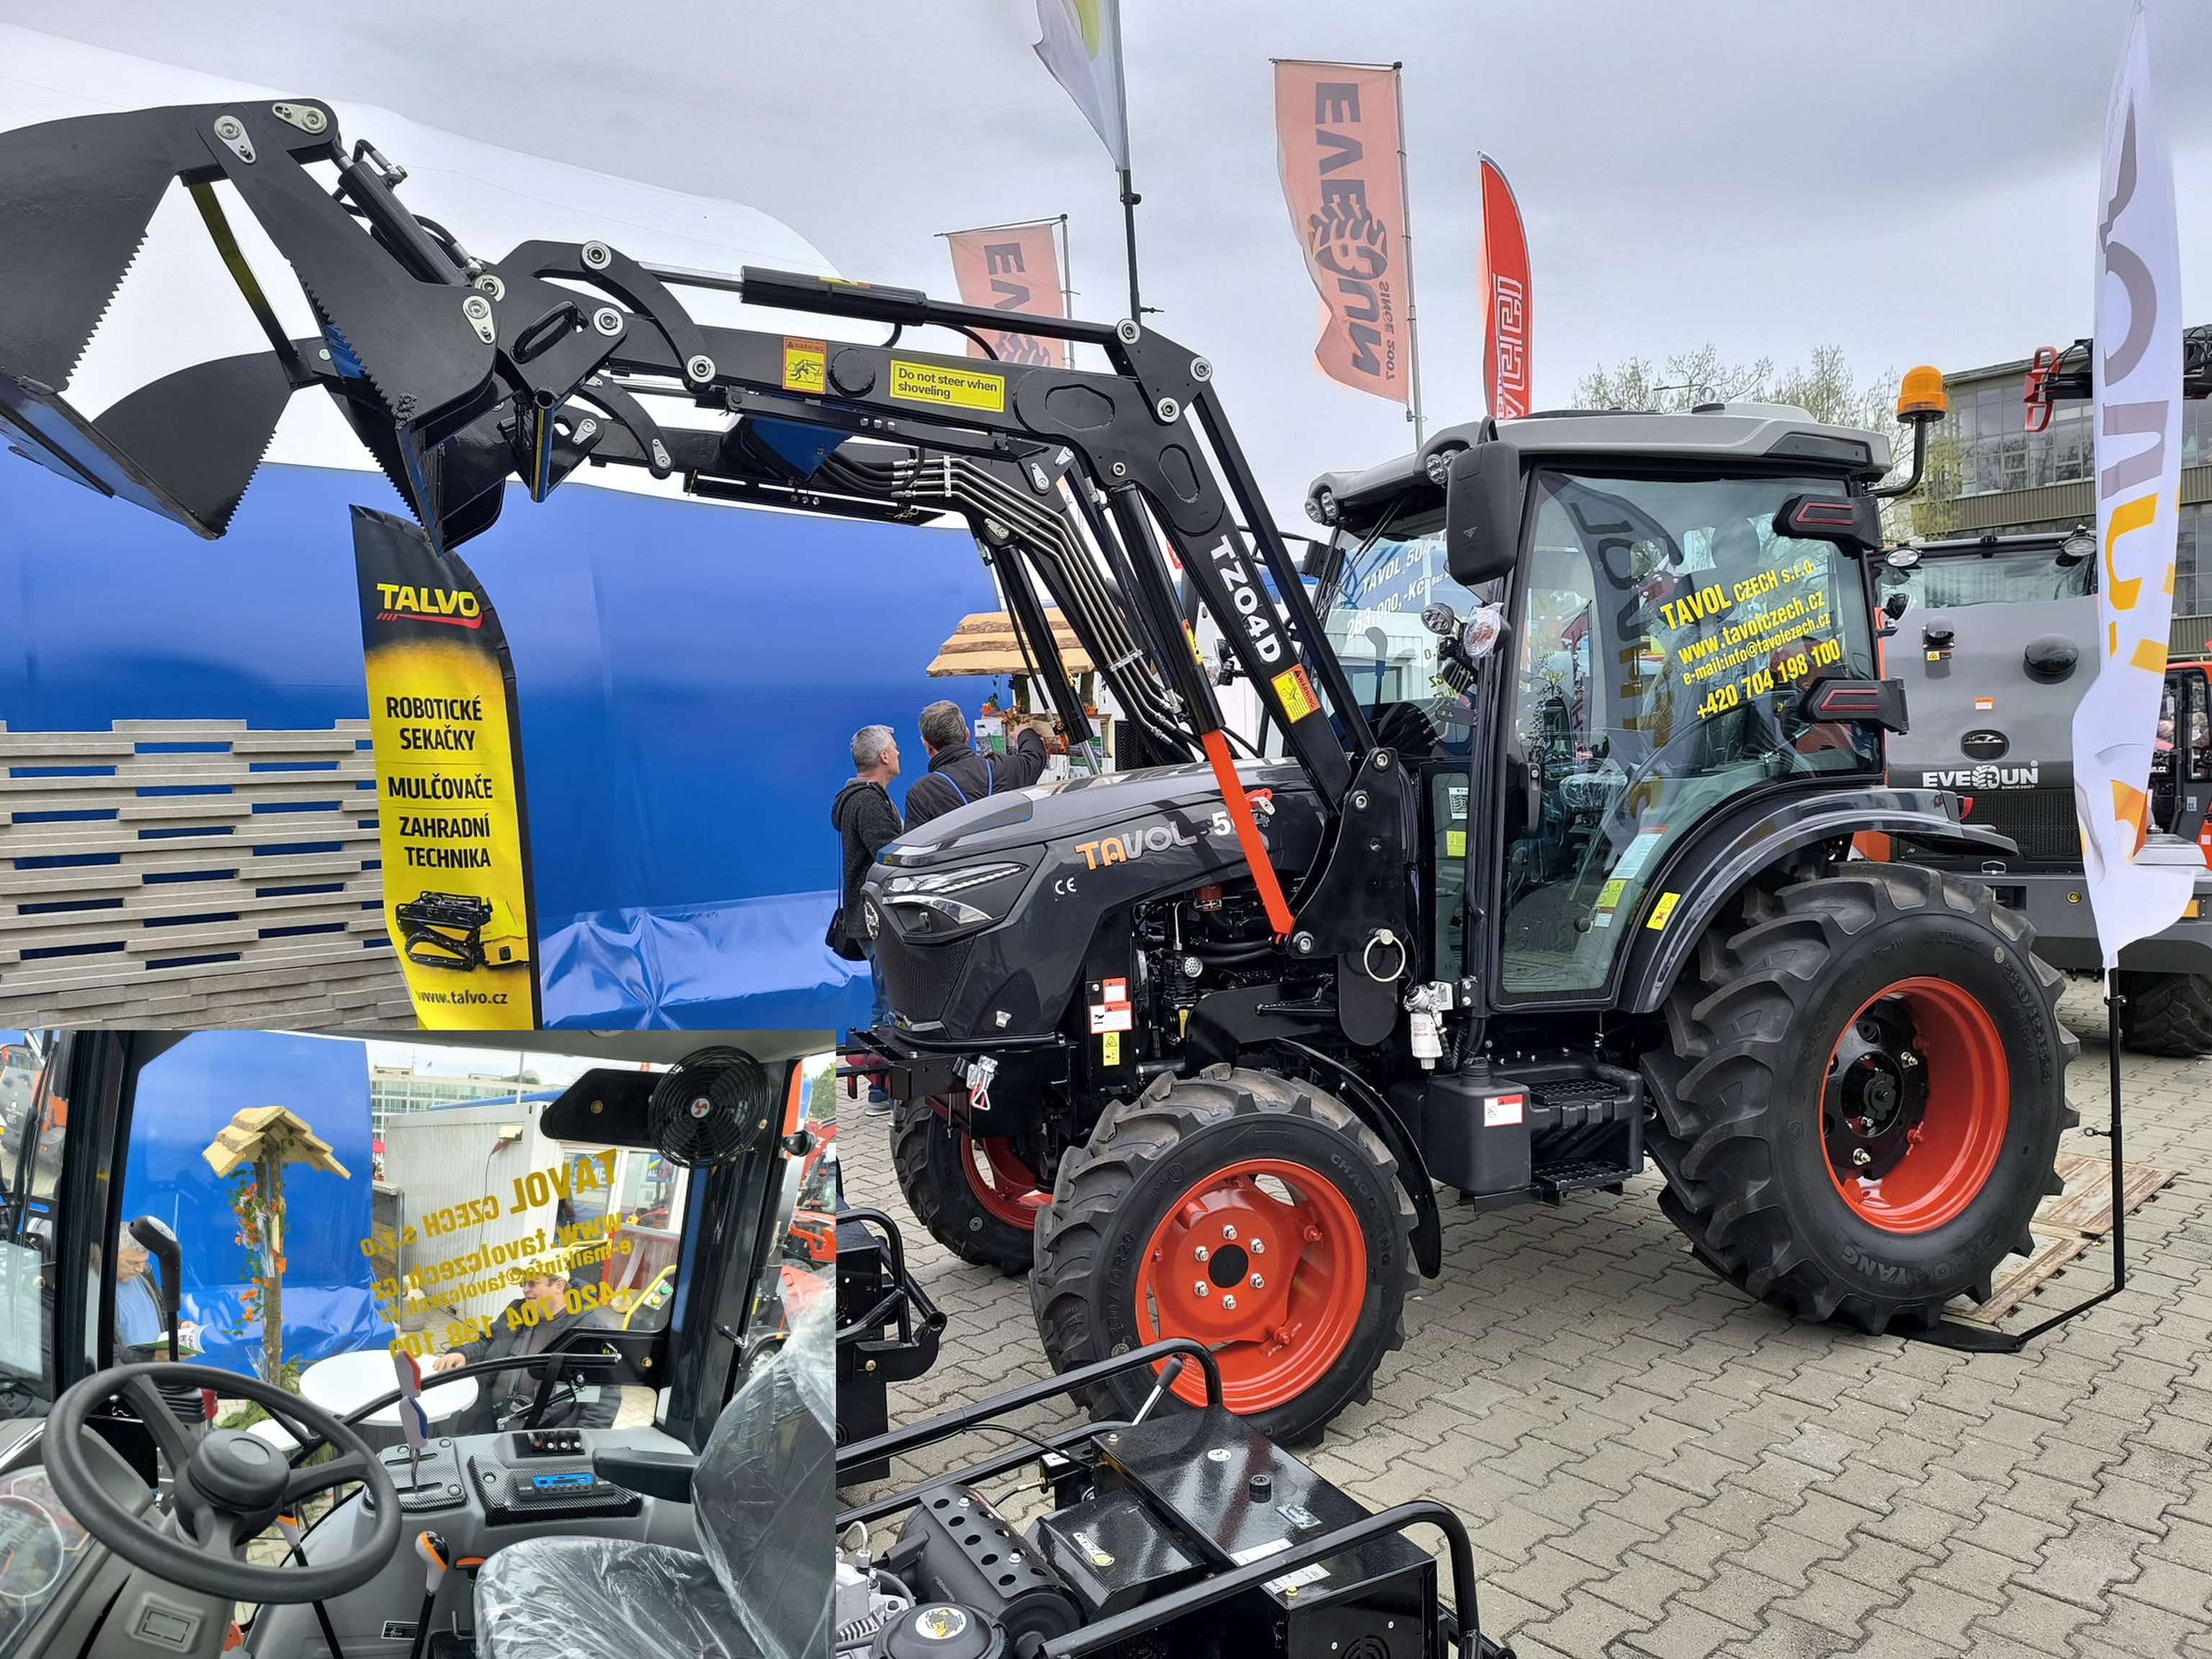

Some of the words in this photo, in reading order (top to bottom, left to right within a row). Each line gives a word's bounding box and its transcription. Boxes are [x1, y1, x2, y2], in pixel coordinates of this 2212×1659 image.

[898, 381, 951, 400] shoveling
[899, 367, 914, 379] Do
[917, 371, 936, 384] not
[938, 374, 965, 388] steer
[966, 379, 998, 392] when
[1362, 557, 1401, 595] TAVOL
[377, 583, 481, 617] TALVO
[1660, 583, 1732, 631] TAVOL
[1733, 570, 1779, 603] CZECH
[1677, 590, 1826, 666] www.tavolczech.cz
[1682, 611, 1831, 686] e-mail:info@tavolczech.cz
[1697, 684, 1739, 719] +420
[1742, 670, 1774, 705] 704
[1777, 653, 1809, 685] 198
[1810, 638, 1842, 670] 100
[1298, 678, 1317, 709] WARNING
[386, 696, 483, 721] ROBOTICKÉ
[399, 724, 476, 751] SEKAČKY
[388, 773, 493, 799] MULČOVAČE
[399, 813, 490, 838] ZAHRADNÍ
[404, 846, 491, 868] TECHNIKA
[1075, 821, 1197, 871] TAVOL
[415, 989, 508, 1005] www.talvo.cz
